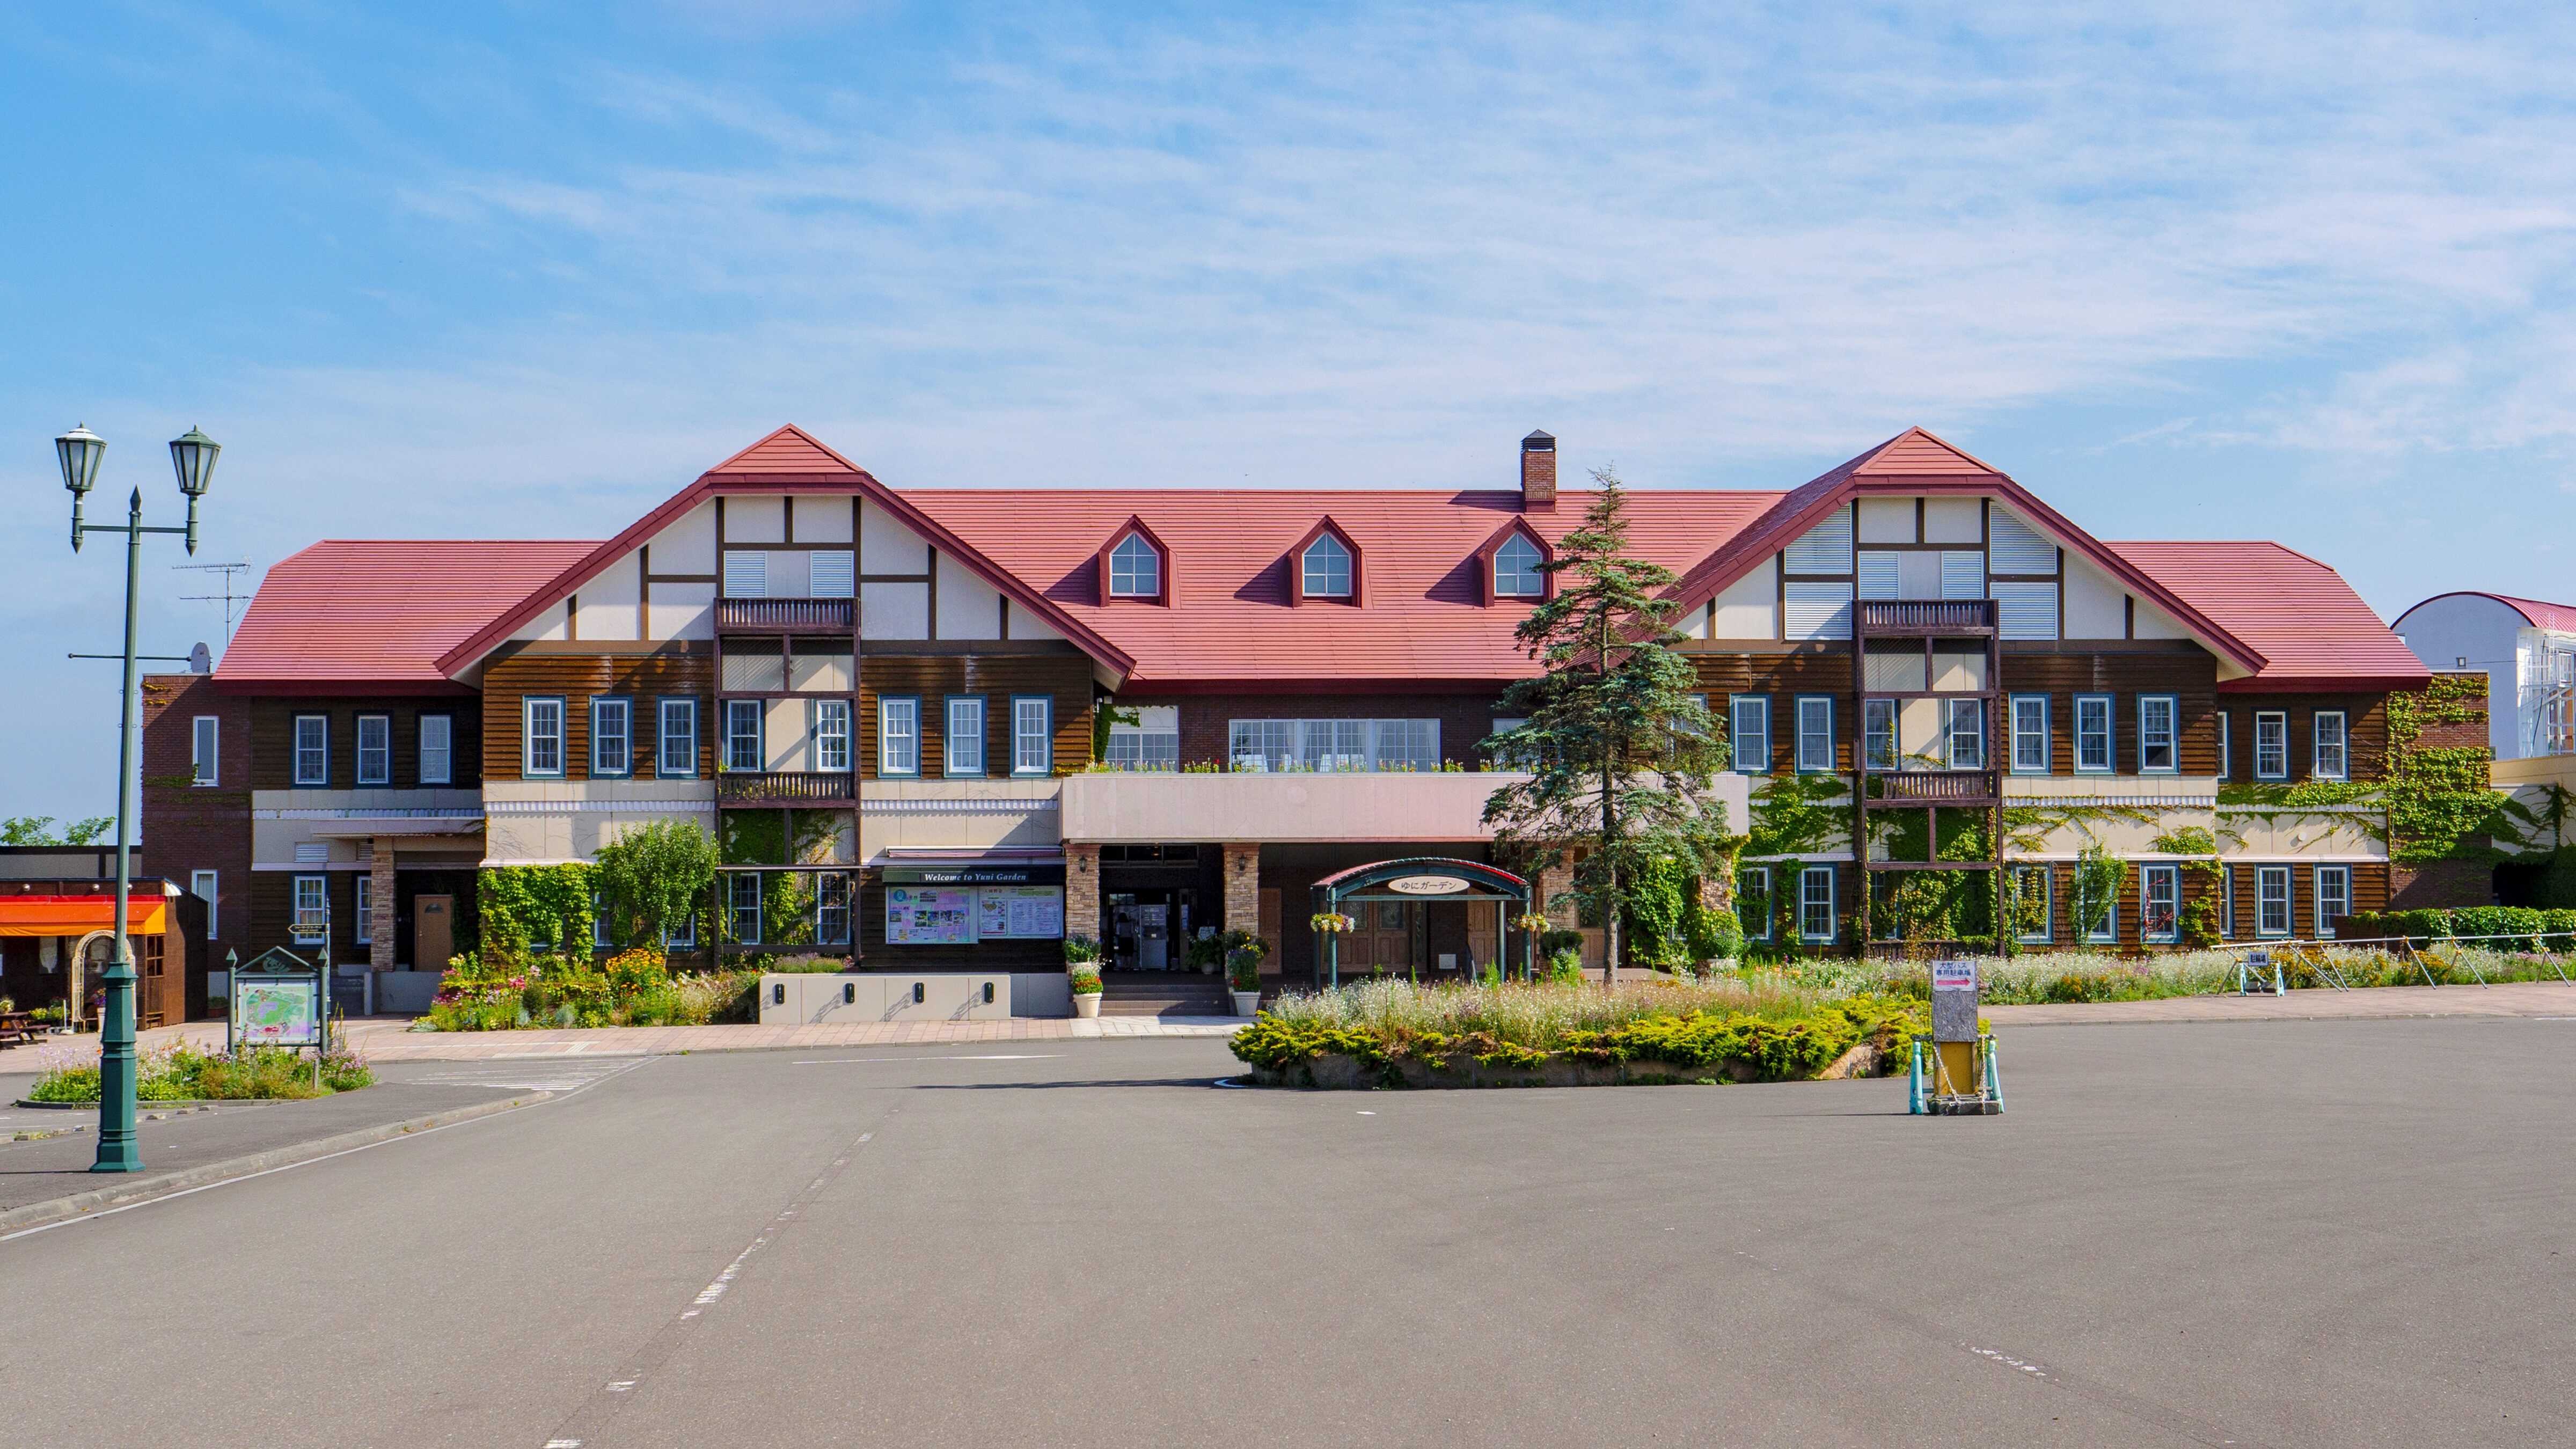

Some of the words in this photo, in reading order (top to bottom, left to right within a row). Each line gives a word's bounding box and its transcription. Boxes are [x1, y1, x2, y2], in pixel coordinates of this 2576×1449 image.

[1401, 881, 1457, 890] ゆにガーデン
